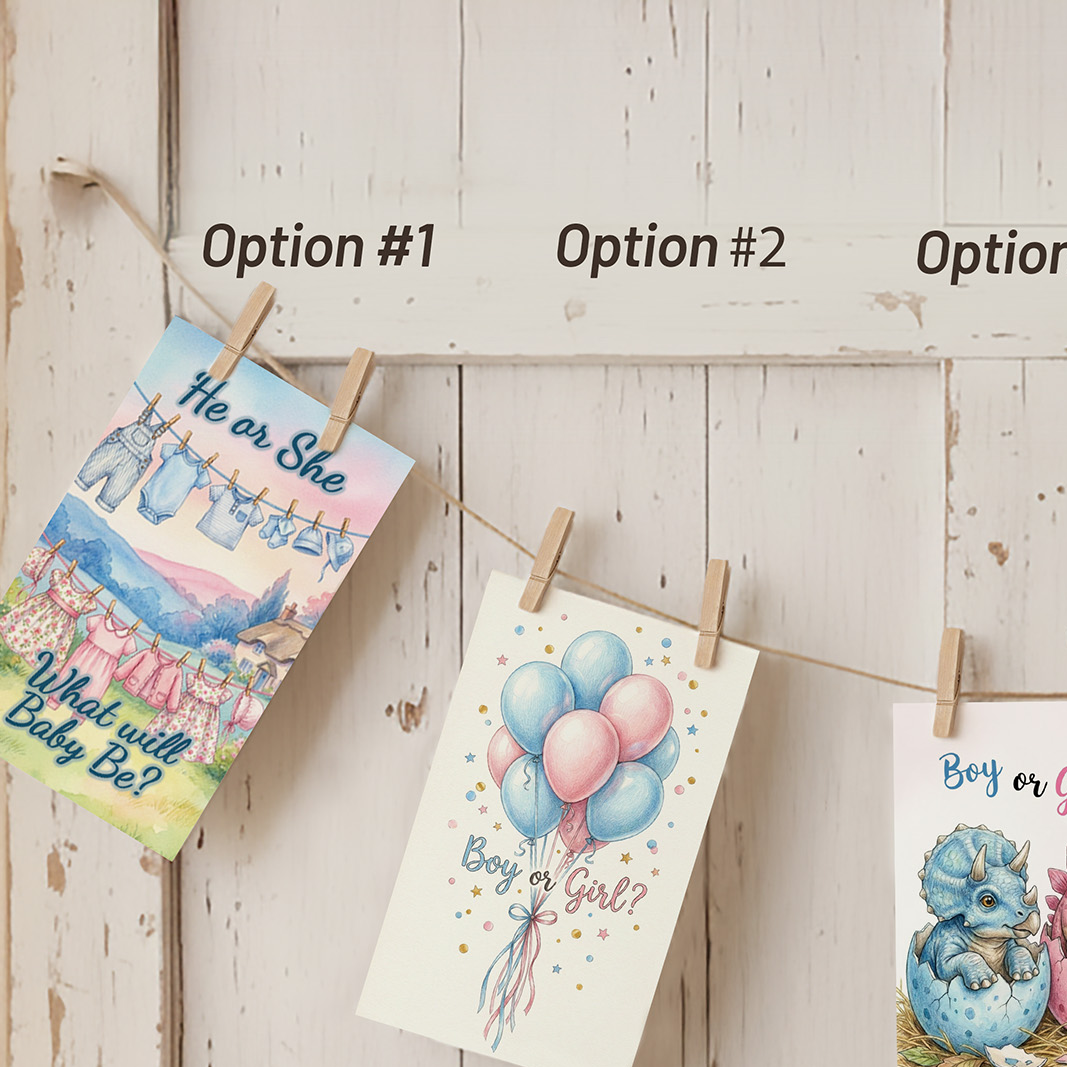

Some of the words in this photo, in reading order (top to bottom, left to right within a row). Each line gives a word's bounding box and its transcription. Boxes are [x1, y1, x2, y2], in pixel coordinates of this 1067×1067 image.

[178, 371, 229, 422] He
[230, 418, 272, 449] or
[276, 432, 346, 493] She
[5, 690, 85, 765] Baby
[88, 741, 163, 796] Be?
[27, 651, 122, 727] What
[117, 723, 193, 765] will
[938, 752, 1004, 798] Boy
[1012, 772, 1048, 798] or
[461, 834, 523, 895] Boy
[529, 869, 558, 892] or
[564, 866, 648, 916] Girl?
